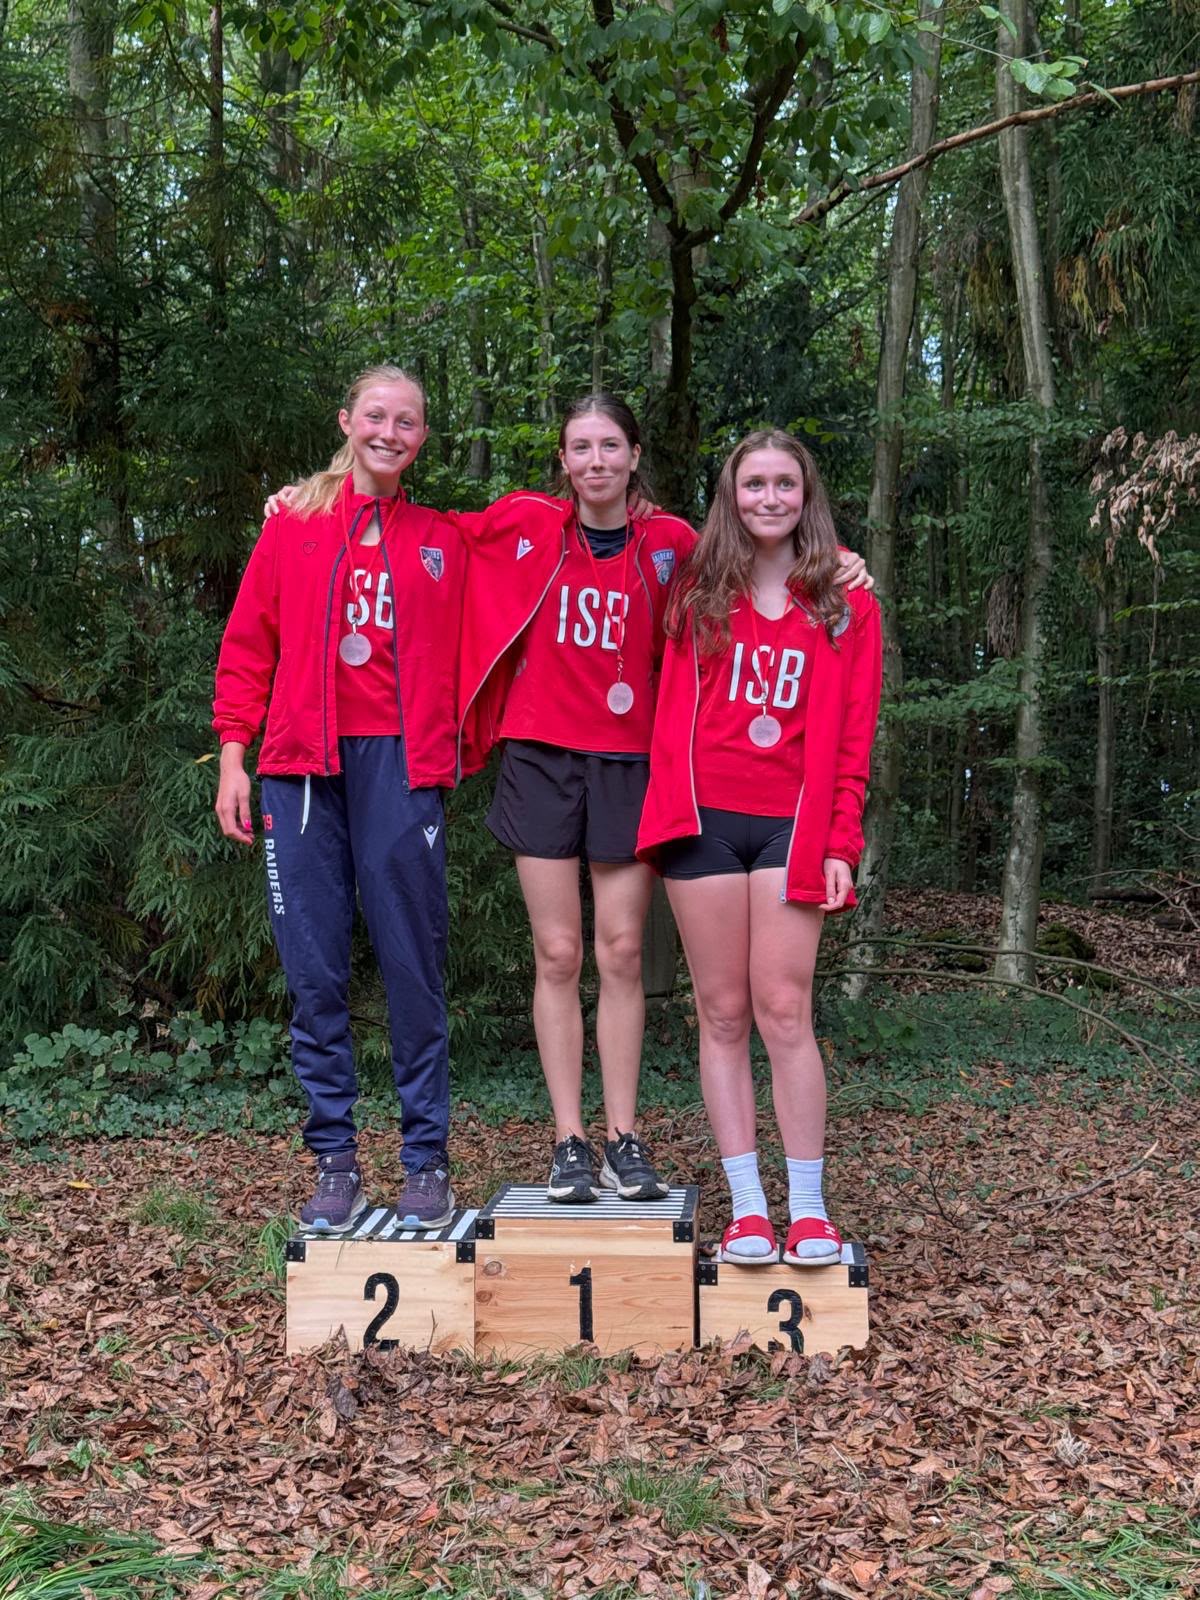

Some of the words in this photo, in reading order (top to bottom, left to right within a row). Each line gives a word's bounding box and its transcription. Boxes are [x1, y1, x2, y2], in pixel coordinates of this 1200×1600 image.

[555, 584, 630, 650] ISB
[727, 641, 806, 710] ISB
[264, 838, 286, 916] RAIDERS
[363, 1272, 400, 1352] 2
[569, 1267, 594, 1343] 1
[767, 1289, 805, 1354] 3
